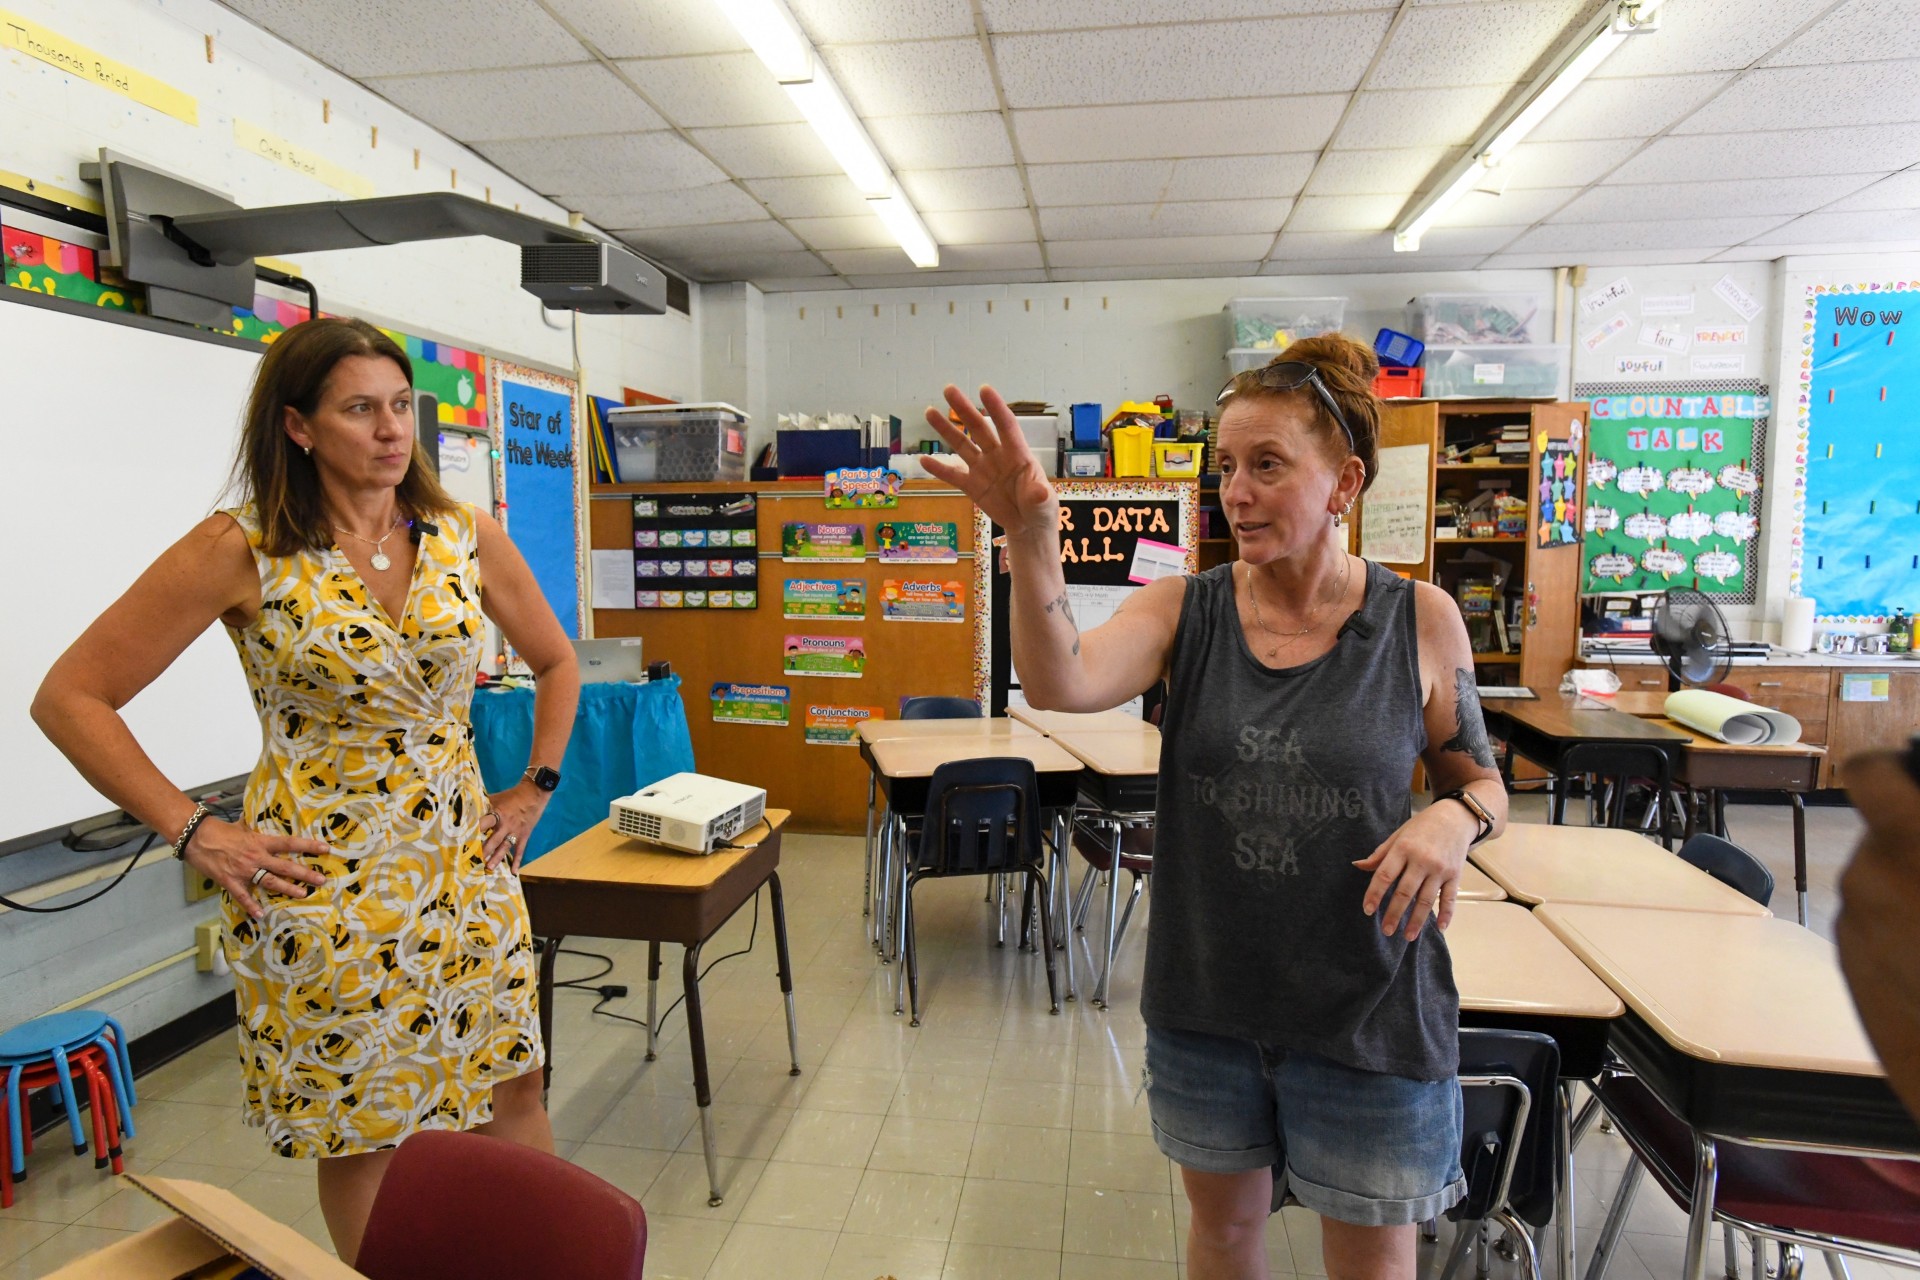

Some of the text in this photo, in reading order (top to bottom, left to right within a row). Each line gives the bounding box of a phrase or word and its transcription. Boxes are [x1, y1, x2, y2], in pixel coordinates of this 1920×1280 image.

[7, 22, 129, 91] Thousands Period
[1654, 329, 1675, 347] fair
[1588, 395, 1771, 417] CCOUNTABLE
[509, 402, 562, 435] Star of
[1627, 429, 1723, 452] TALK
[506, 439, 533, 467] the
[841, 467, 882, 480] Parts of
[842, 480, 880, 492] Speech
[914, 523, 943, 534] Verbs
[1093, 506, 1170, 533] DATA
[817, 525, 847, 535] Nouns
[1060, 537, 1124, 563] ALL
[789, 581, 836, 593] Adjectives
[902, 581, 942, 592] Adverbs
[802, 636, 845, 648] Pronouns
[731, 684, 787, 697] Prepositions
[810, 705, 870, 718] Conjunctions
[1236, 725, 1305, 764] SEA
[1188, 774, 1364, 819] TO SHINING
[1232, 831, 1300, 876] SEA
